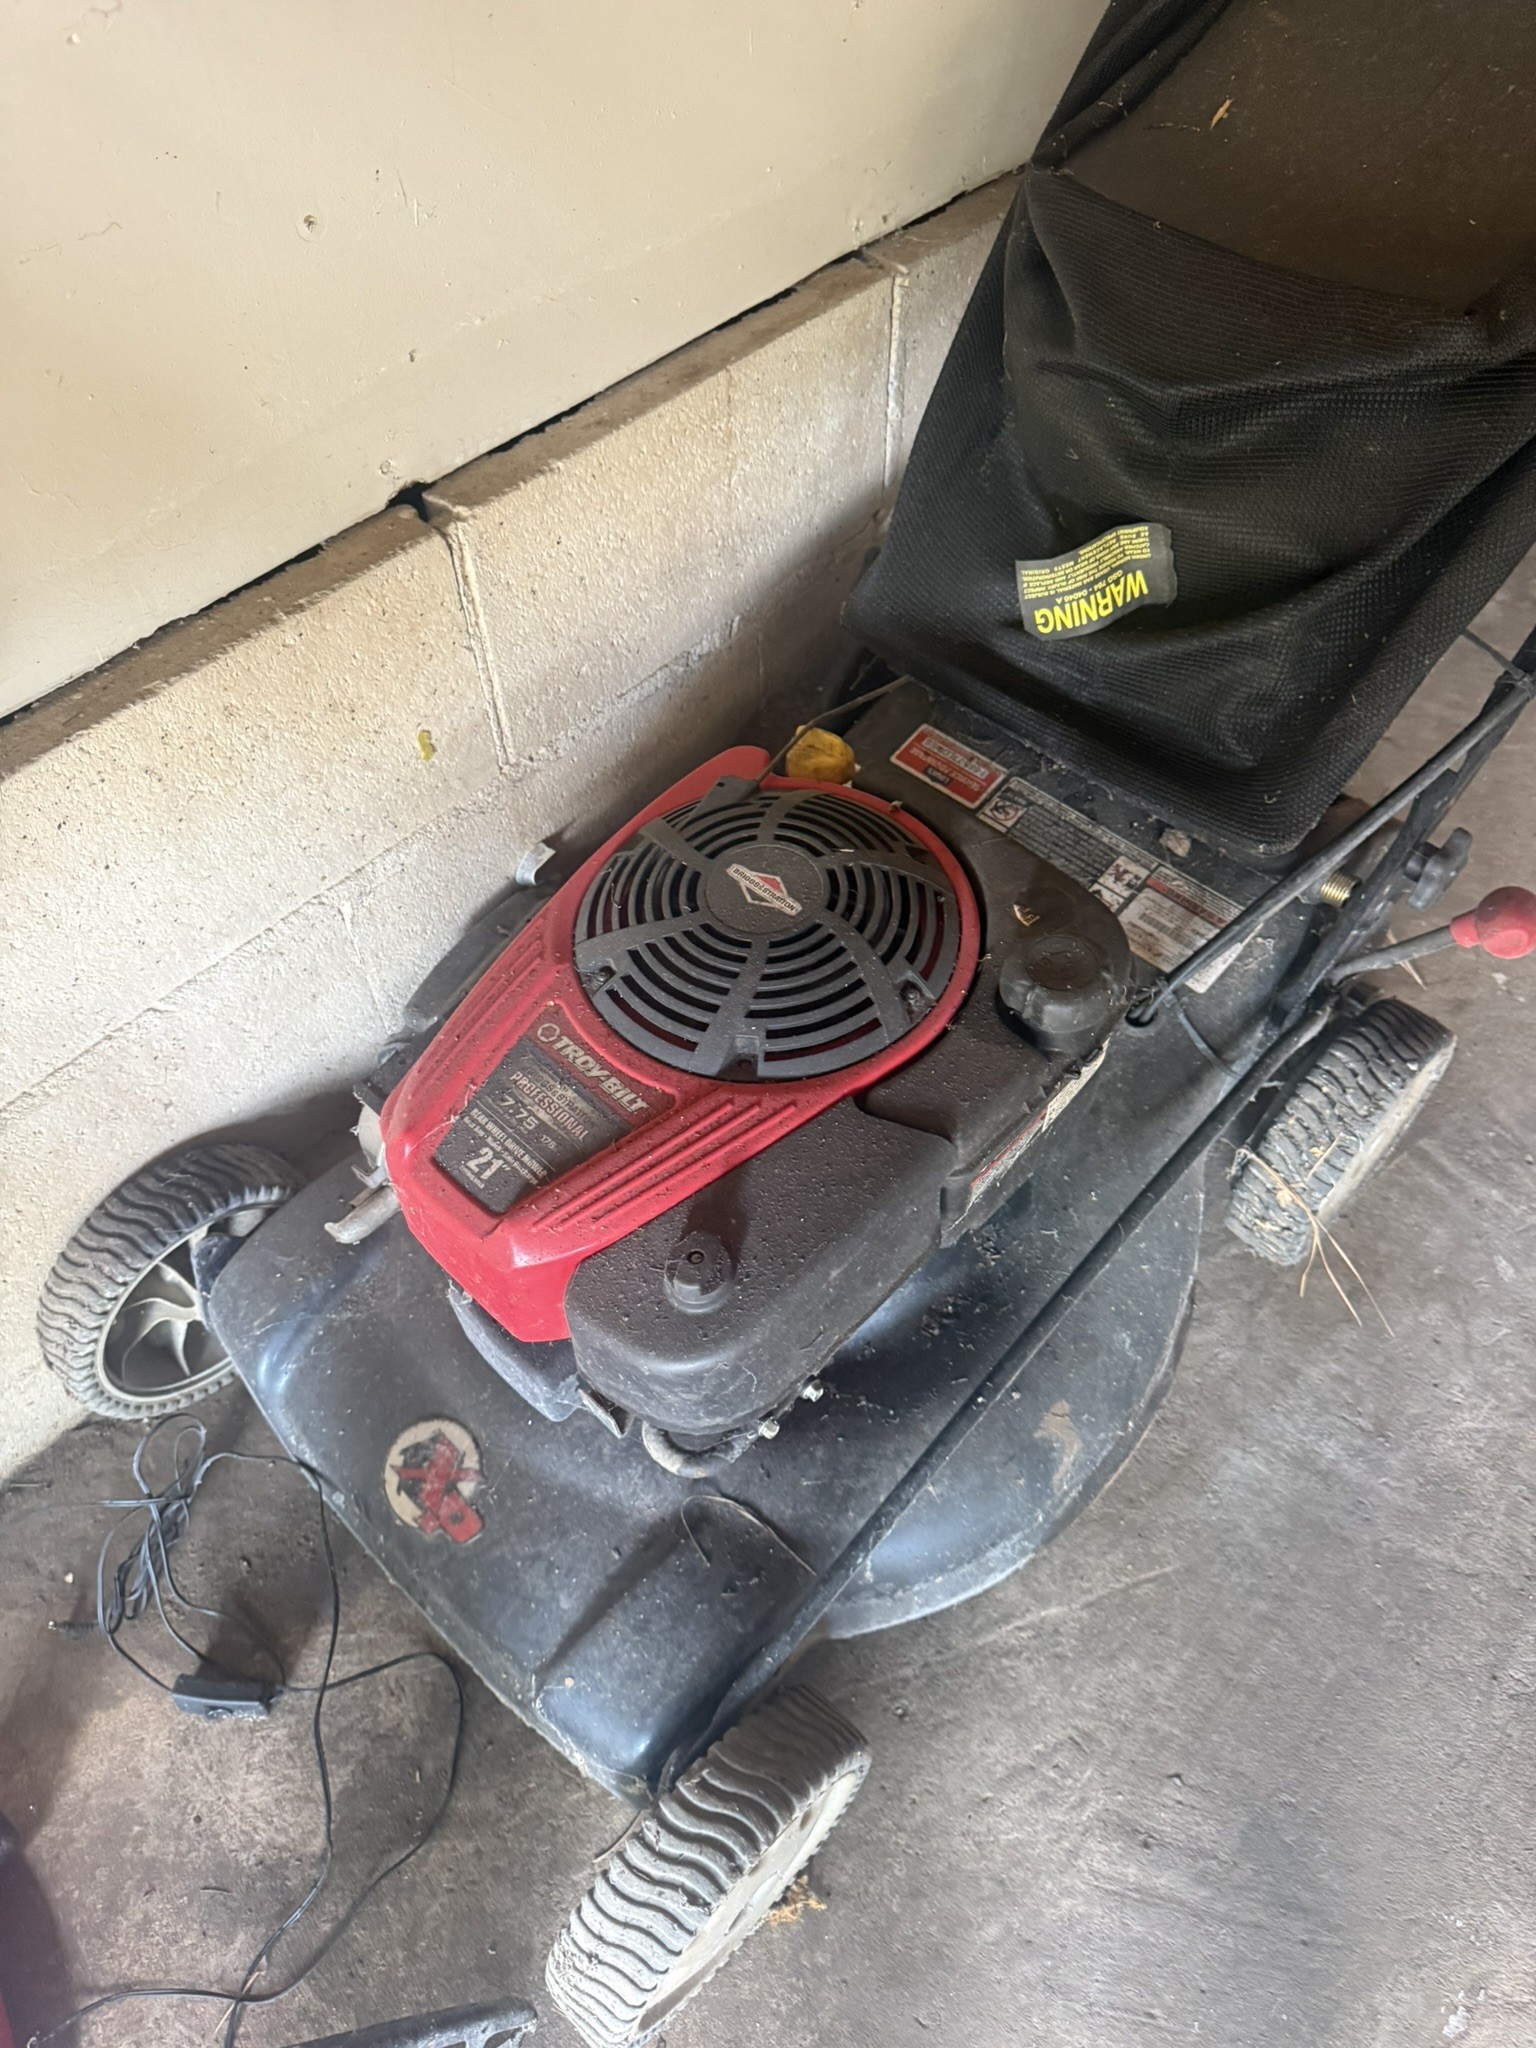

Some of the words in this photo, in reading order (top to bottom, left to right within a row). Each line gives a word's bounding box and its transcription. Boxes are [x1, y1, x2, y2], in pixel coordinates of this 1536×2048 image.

[1034, 570, 1148, 634] WARNING
[552, 1035, 649, 1112] TROY-BILT
[469, 1107, 488, 1125] REAR
[484, 1120, 508, 1143] WHEEL
[503, 1137, 525, 1158] DRIVE
[501, 1095, 539, 1130] 7.75
[510, 1071, 589, 1141] PROFESSIONAL
